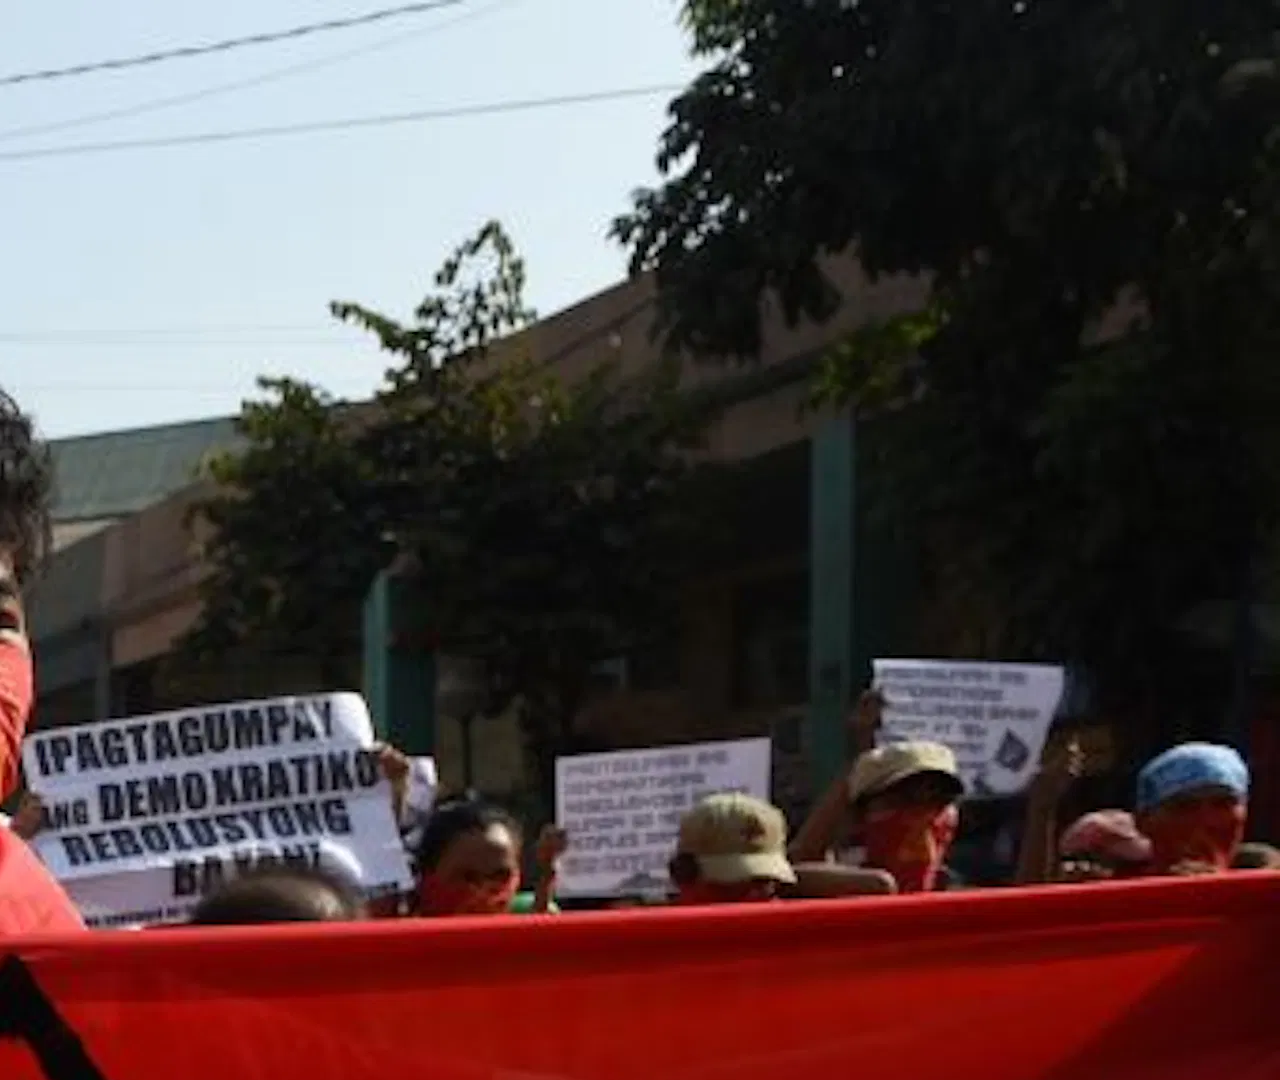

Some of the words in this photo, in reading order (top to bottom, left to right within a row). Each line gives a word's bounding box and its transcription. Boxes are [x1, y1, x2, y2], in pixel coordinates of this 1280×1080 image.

[35, 702, 333, 777] IPAGTAGUMPAY
[42, 803, 90, 830] ANG
[61, 799, 351, 866] REBOLUSYONG
